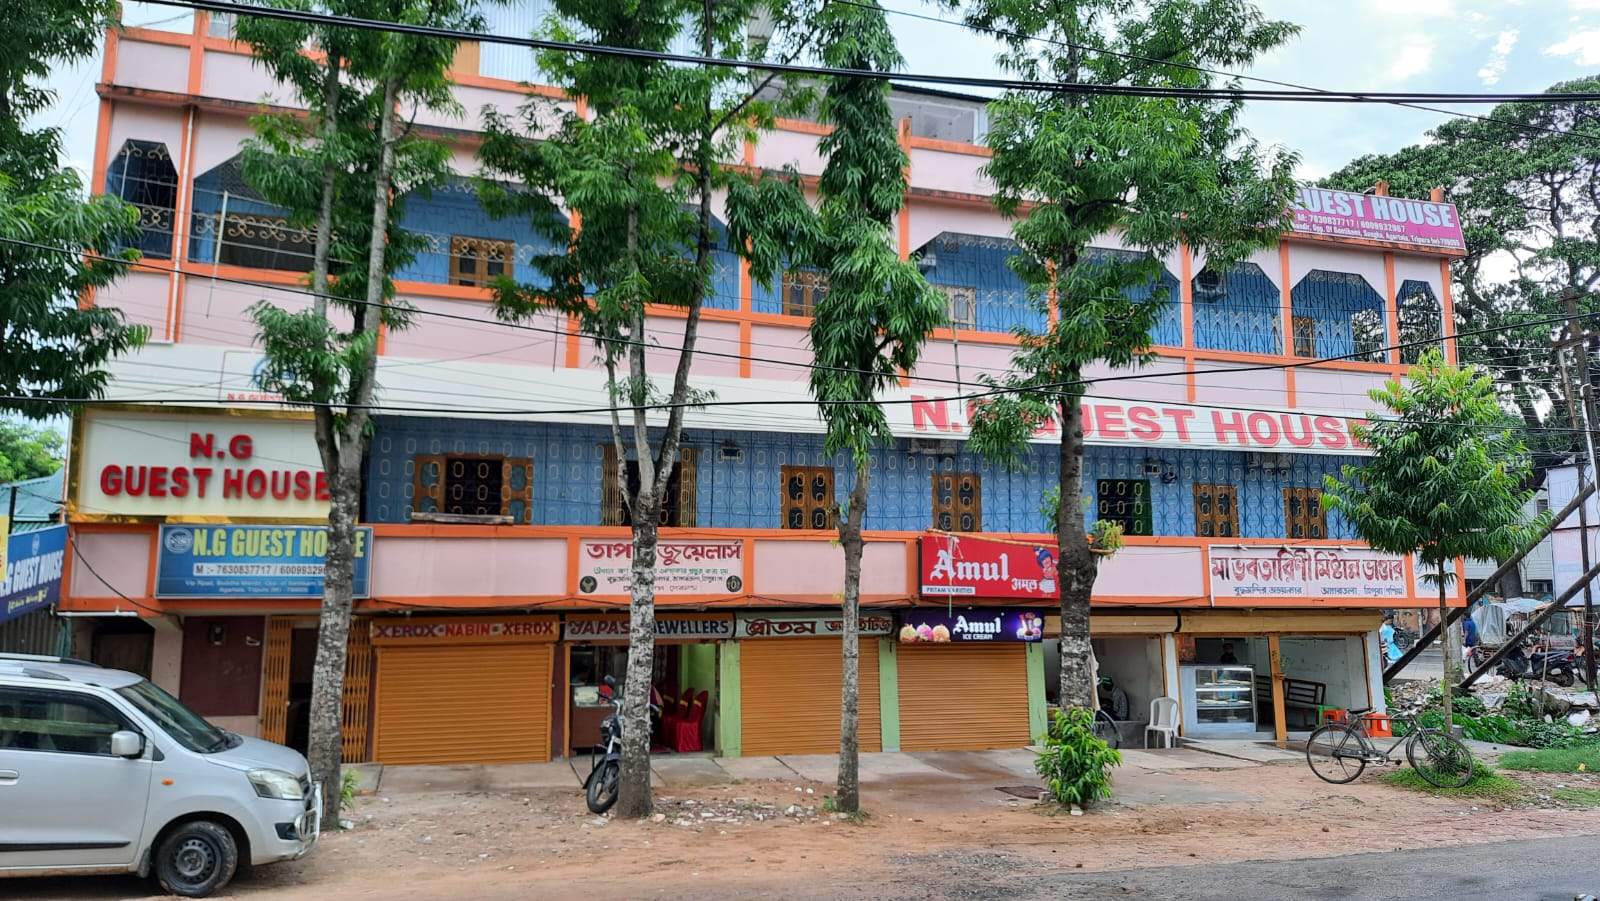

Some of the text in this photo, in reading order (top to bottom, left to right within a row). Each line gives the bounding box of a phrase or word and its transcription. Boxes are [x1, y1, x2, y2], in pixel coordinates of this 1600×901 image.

[1370, 196, 1456, 228] HOUSE
[189, 432, 254, 460] N.G
[100, 464, 331, 501] GUEST HOUSE
[193, 528, 227, 557] N.G
[231, 529, 296, 557] GUEST
[300, 530, 366, 558] HOE
[586, 543, 634, 559] তাপ
[929, 549, 1009, 581] Amul
[1211, 556, 1230, 581] মা
[374, 621, 555, 638] XEROX NABIN XEROX
[952, 615, 1002, 635] Amul
[973, 633, 993, 641] CREAM
